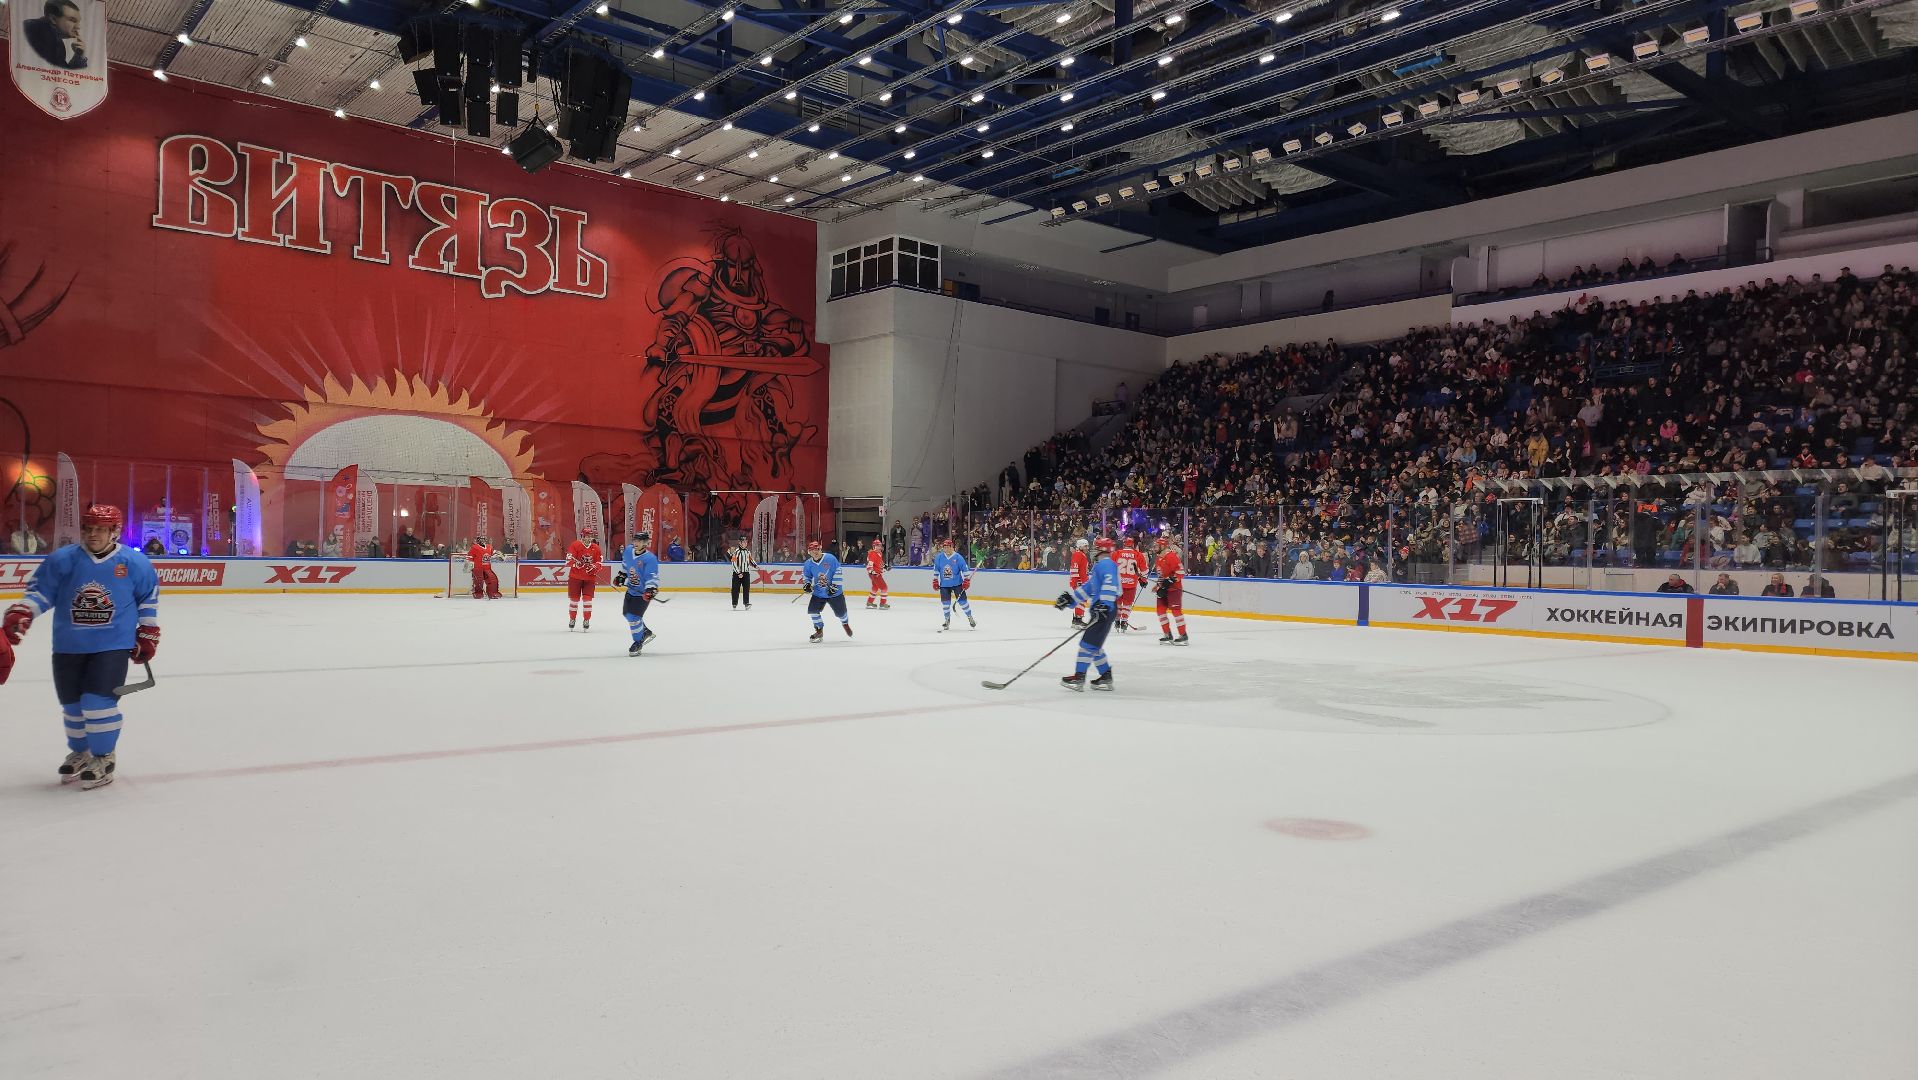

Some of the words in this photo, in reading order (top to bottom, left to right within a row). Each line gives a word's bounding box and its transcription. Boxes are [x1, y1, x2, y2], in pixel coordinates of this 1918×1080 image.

[40, 75, 80, 86] ЗАЧЕСОВ
[152, 133, 609, 299] ВИТЯЗЬ
[0, 564, 41, 583] 17
[154, 568, 218, 582] РОССИИ.РФ
[1546, 606, 1684, 629] ХОККЕЙНАЯ
[1707, 614, 1895, 640] ЭКИПИРОВКА
